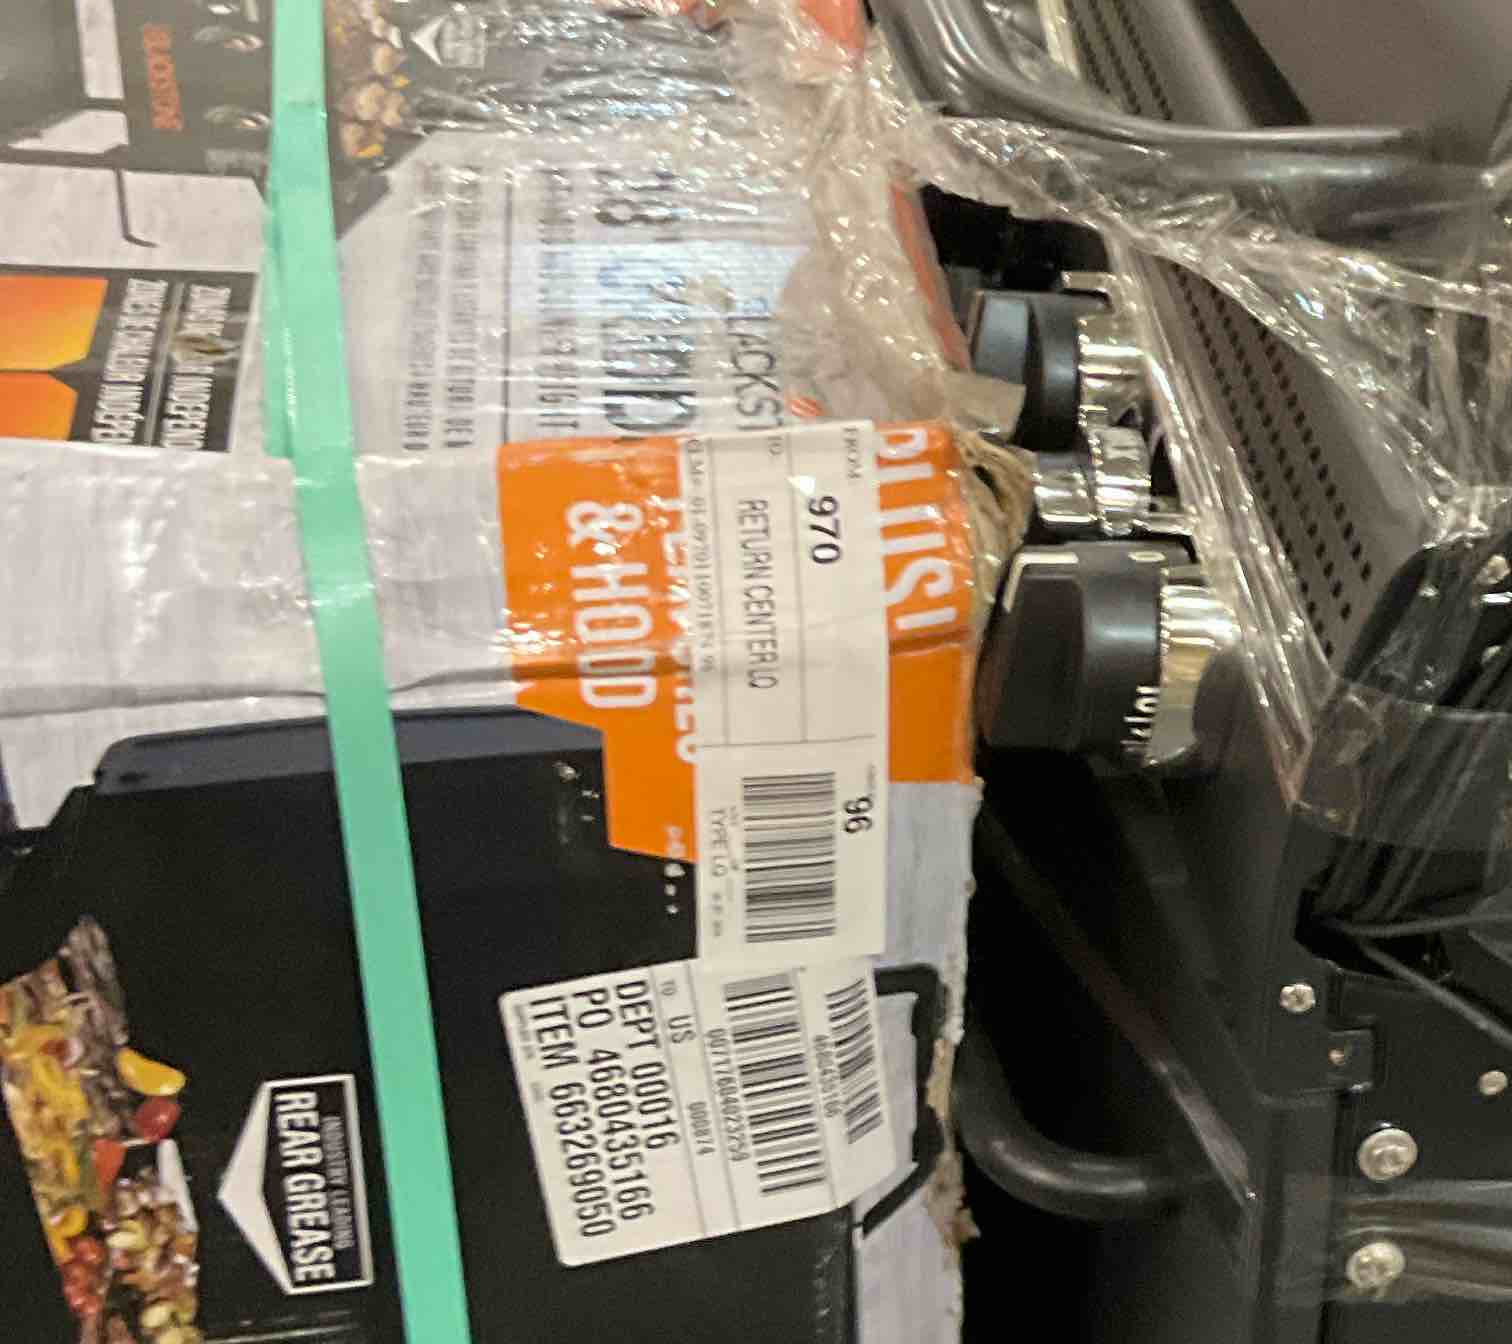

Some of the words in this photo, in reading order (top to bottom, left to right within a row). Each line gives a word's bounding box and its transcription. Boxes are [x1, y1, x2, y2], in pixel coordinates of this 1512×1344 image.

[565, 499, 644, 549] &
[737, 498, 770, 579] RETURN
[808, 495, 842, 565] 970
[571, 562, 658, 709] HOOD
[745, 585, 777, 663] CENTER
[711, 807, 729, 849] TYPE
[842, 796, 872, 835] 96
[528, 994, 580, 1071] ITEM
[572, 987, 613, 1030] PO
[614, 980, 662, 1052] DEPT
[667, 1015, 696, 1045] US
[273, 1091, 323, 1168] REAR
[588, 1047, 655, 1222] 4680435166
[631, 1060, 680, 1150] 00016
[324, 1115, 347, 1186] INDUSTRY
[549, 1081, 616, 1239] 663269050
[283, 1172, 335, 1283] GREASE
[330, 1189, 356, 1251] LEADING
